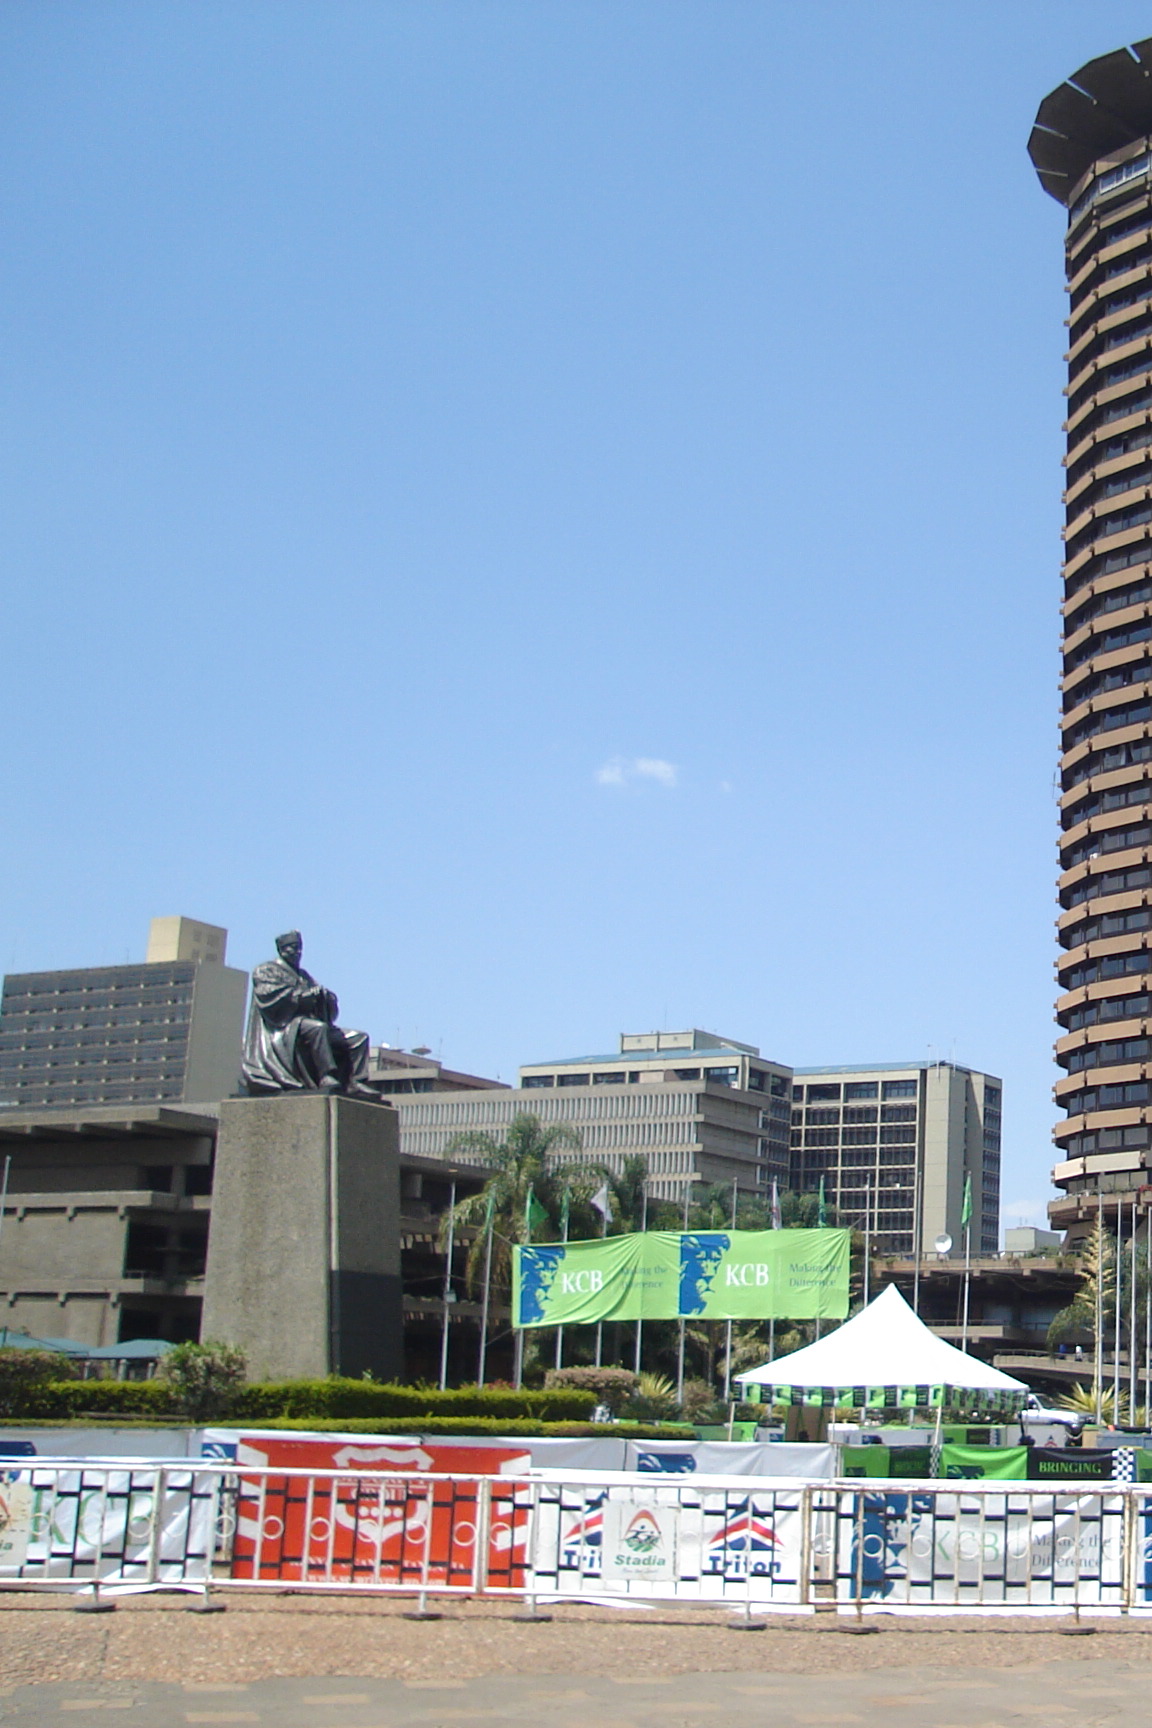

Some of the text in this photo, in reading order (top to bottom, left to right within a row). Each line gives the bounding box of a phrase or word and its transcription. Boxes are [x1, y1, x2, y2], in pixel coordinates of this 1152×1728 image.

[561, 1270, 604, 1294] KCB
[726, 1263, 770, 1287] KCB
[1039, 1461, 1101, 1474] BRINGING
[933, 1530, 1000, 1563] KCB
[614, 1554, 666, 1566] Stadia
